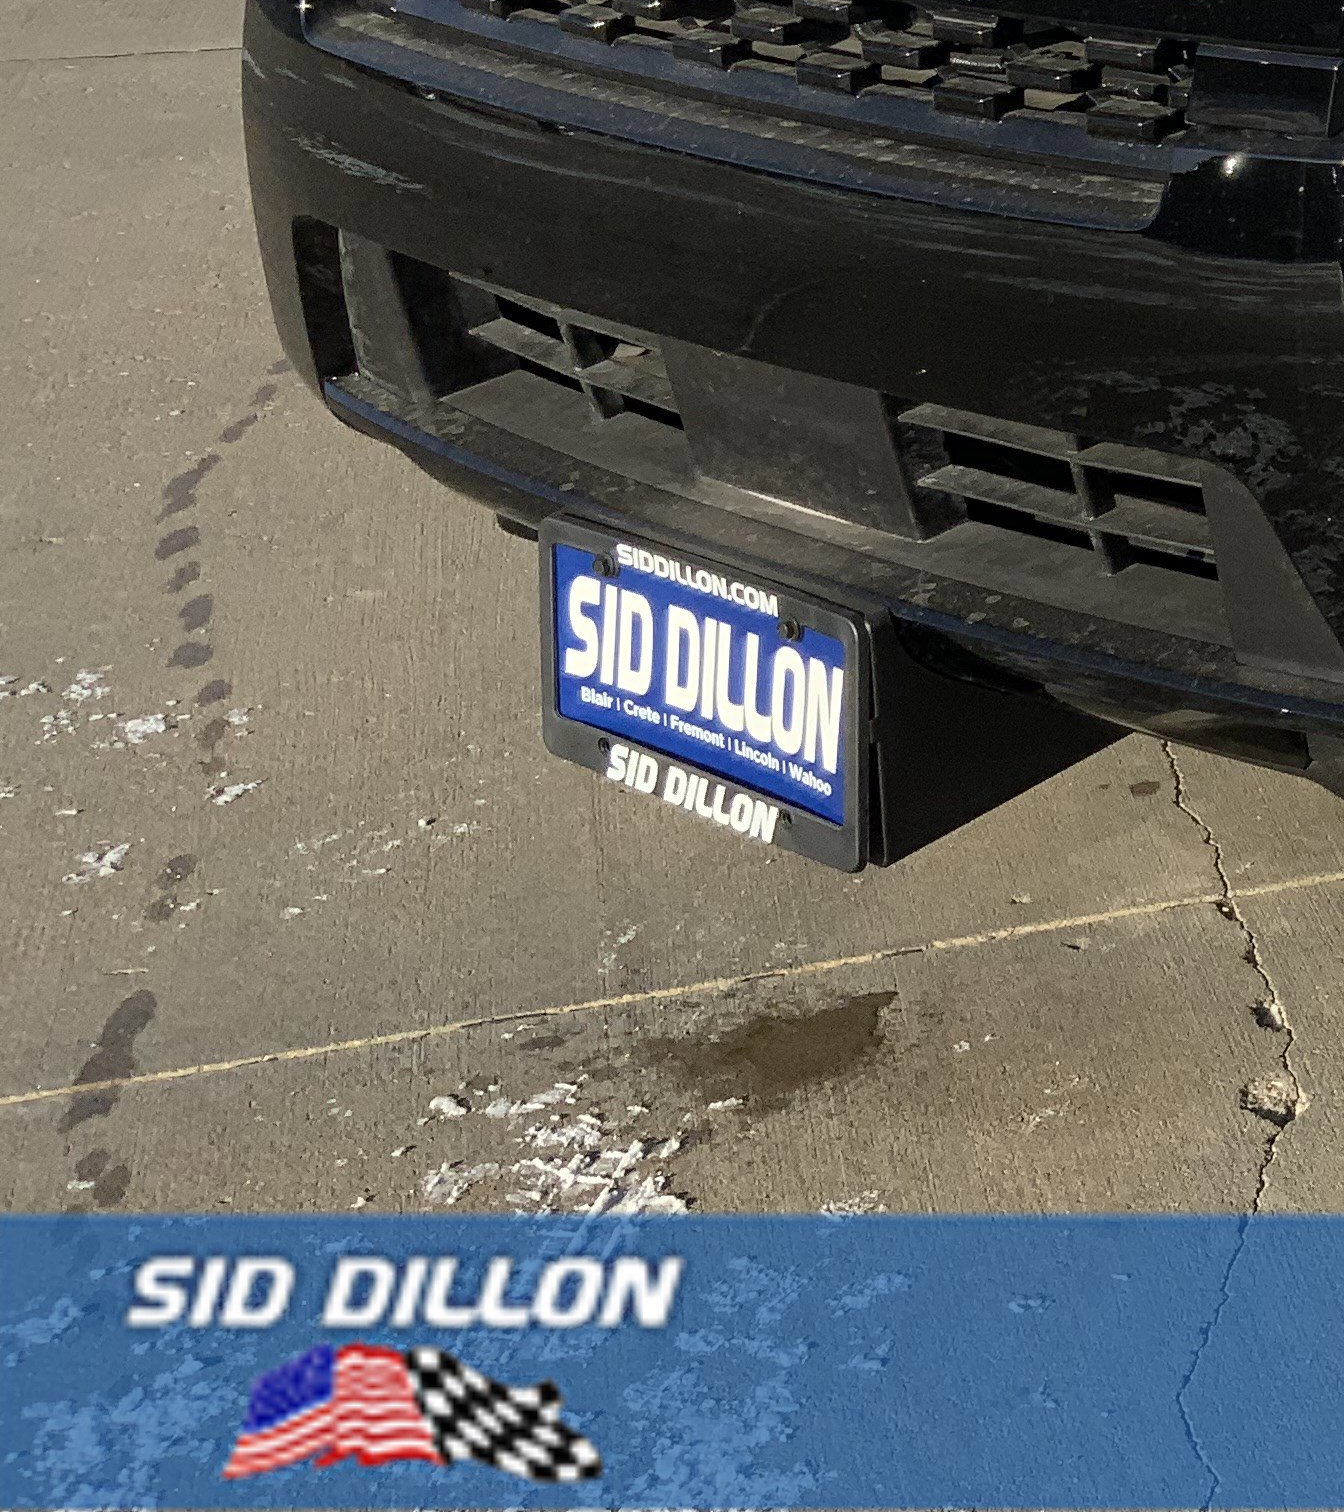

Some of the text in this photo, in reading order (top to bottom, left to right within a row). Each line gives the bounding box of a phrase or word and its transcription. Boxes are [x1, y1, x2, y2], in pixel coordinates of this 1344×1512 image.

[616, 544, 780, 618] SIDDILLON.COM
[564, 575, 844, 774] SID DILLON
[580, 685, 832, 796] Blair Crete Fremont Lincoln Wahoo
[606, 744, 780, 844] SID DILLON
